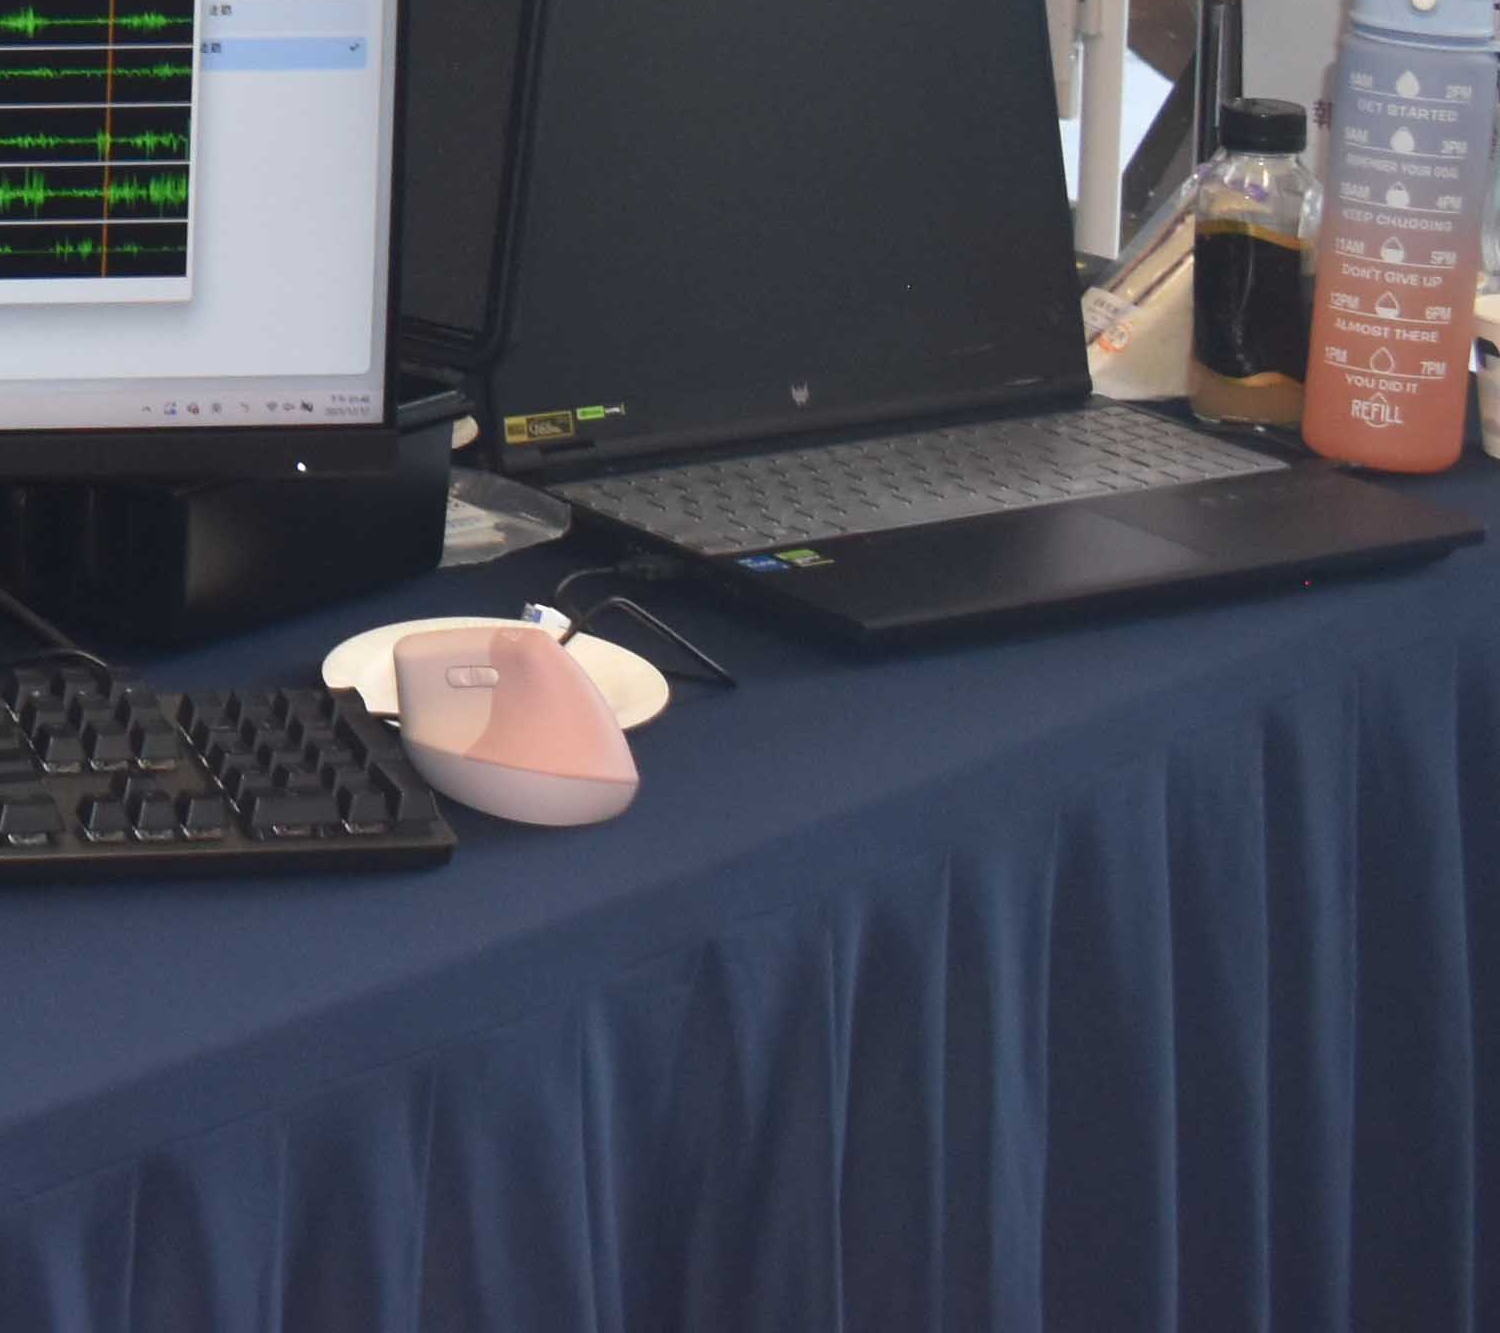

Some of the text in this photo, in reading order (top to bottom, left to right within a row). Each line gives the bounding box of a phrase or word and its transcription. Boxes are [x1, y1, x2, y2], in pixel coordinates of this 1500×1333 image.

[1384, 270, 1421, 286] GIVE
[1423, 276, 1443, 288] UP
[1394, 328, 1439, 343] THERE
[1419, 360, 1447, 376] 7PM
[1345, 374, 1419, 394] YOU DID IT
[1351, 399, 1404, 425] REFILL
